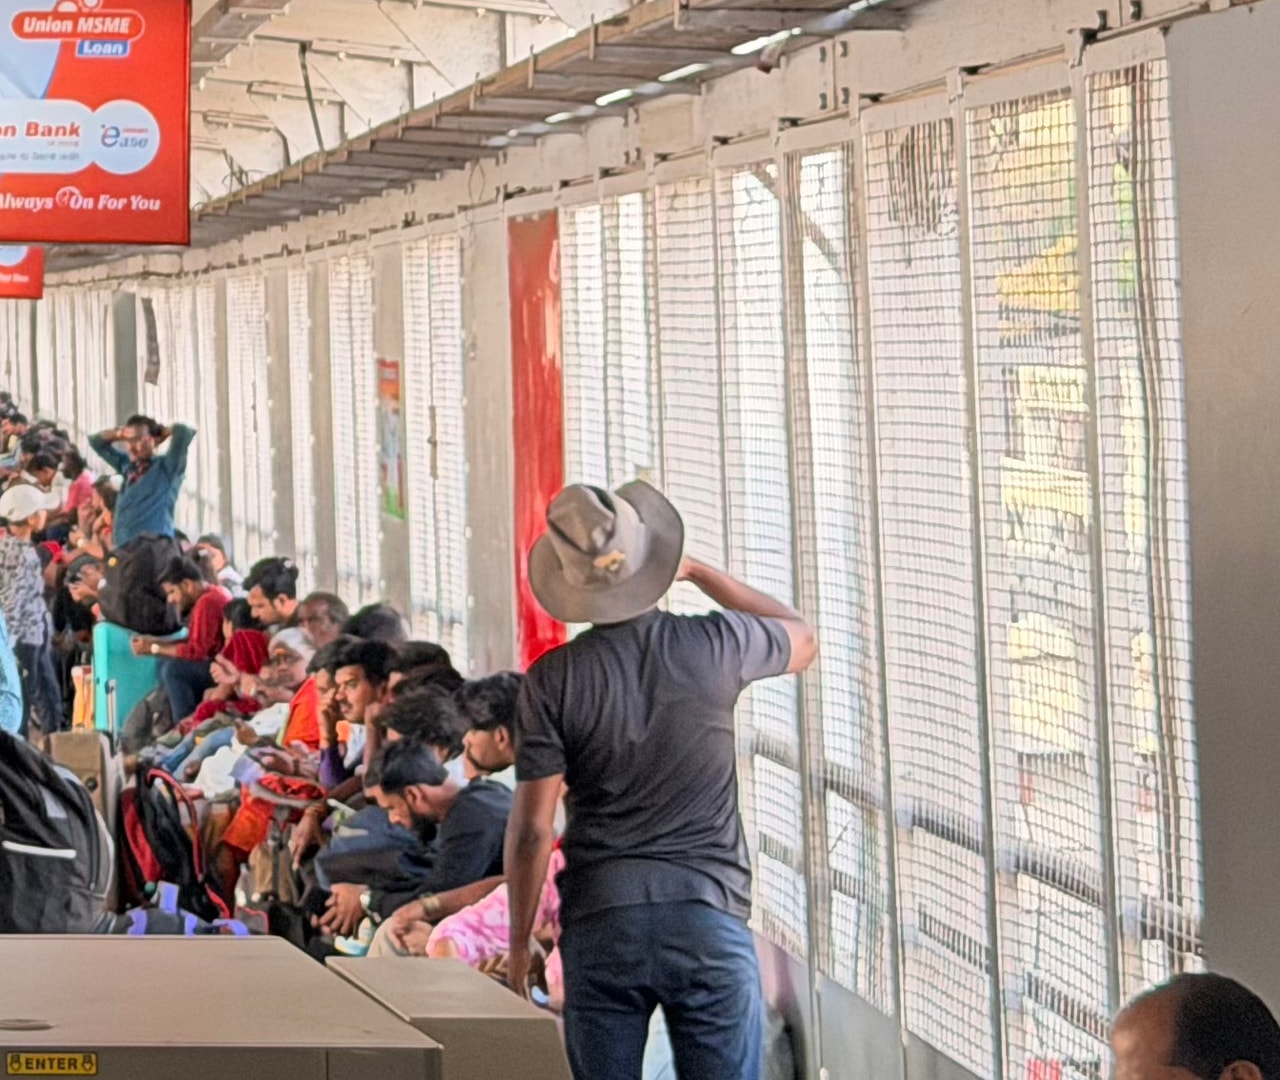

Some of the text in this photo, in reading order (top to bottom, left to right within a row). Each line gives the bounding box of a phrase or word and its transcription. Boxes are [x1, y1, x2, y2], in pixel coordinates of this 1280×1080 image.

[23, 17, 131, 34] Union MSME
[83, 41, 123, 55] Loan
[25, 121, 81, 137] Bank
[98, 194, 128, 210] For
[130, 195, 161, 211] You
[25, 1057, 78, 1070] ENTER
